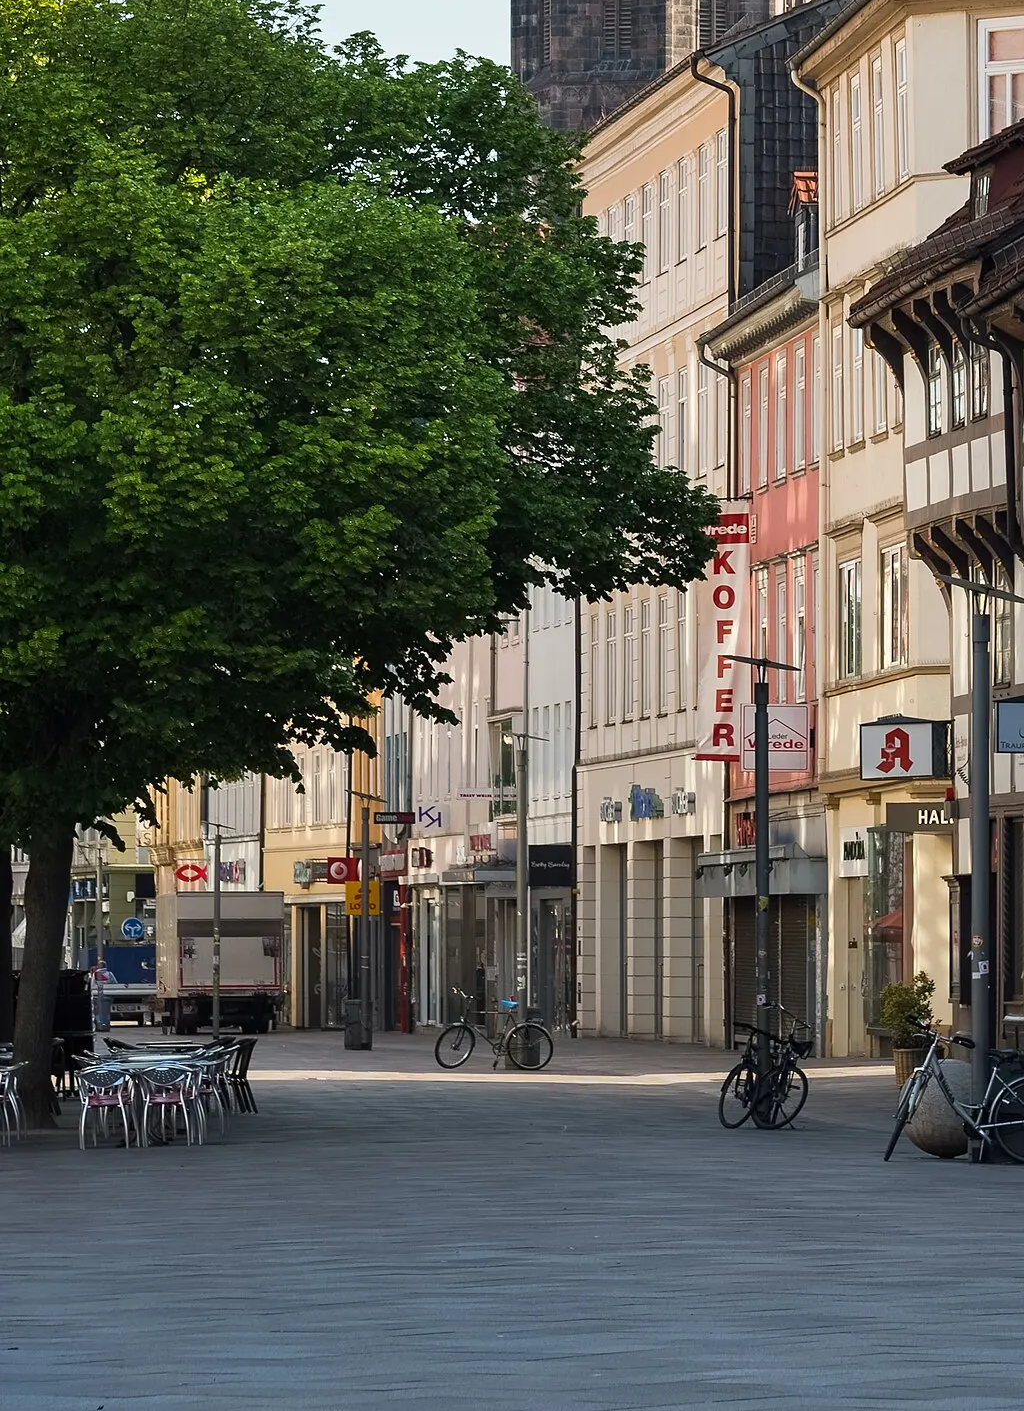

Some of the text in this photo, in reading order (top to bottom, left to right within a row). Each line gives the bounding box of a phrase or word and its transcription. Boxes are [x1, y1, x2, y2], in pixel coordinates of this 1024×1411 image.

[713, 551, 736, 747] KOFFER
[768, 732, 788, 740] Leder
[376, 814, 397, 822] Game
[918, 809, 954, 824] HAL
[349, 902, 376, 910] LOO
